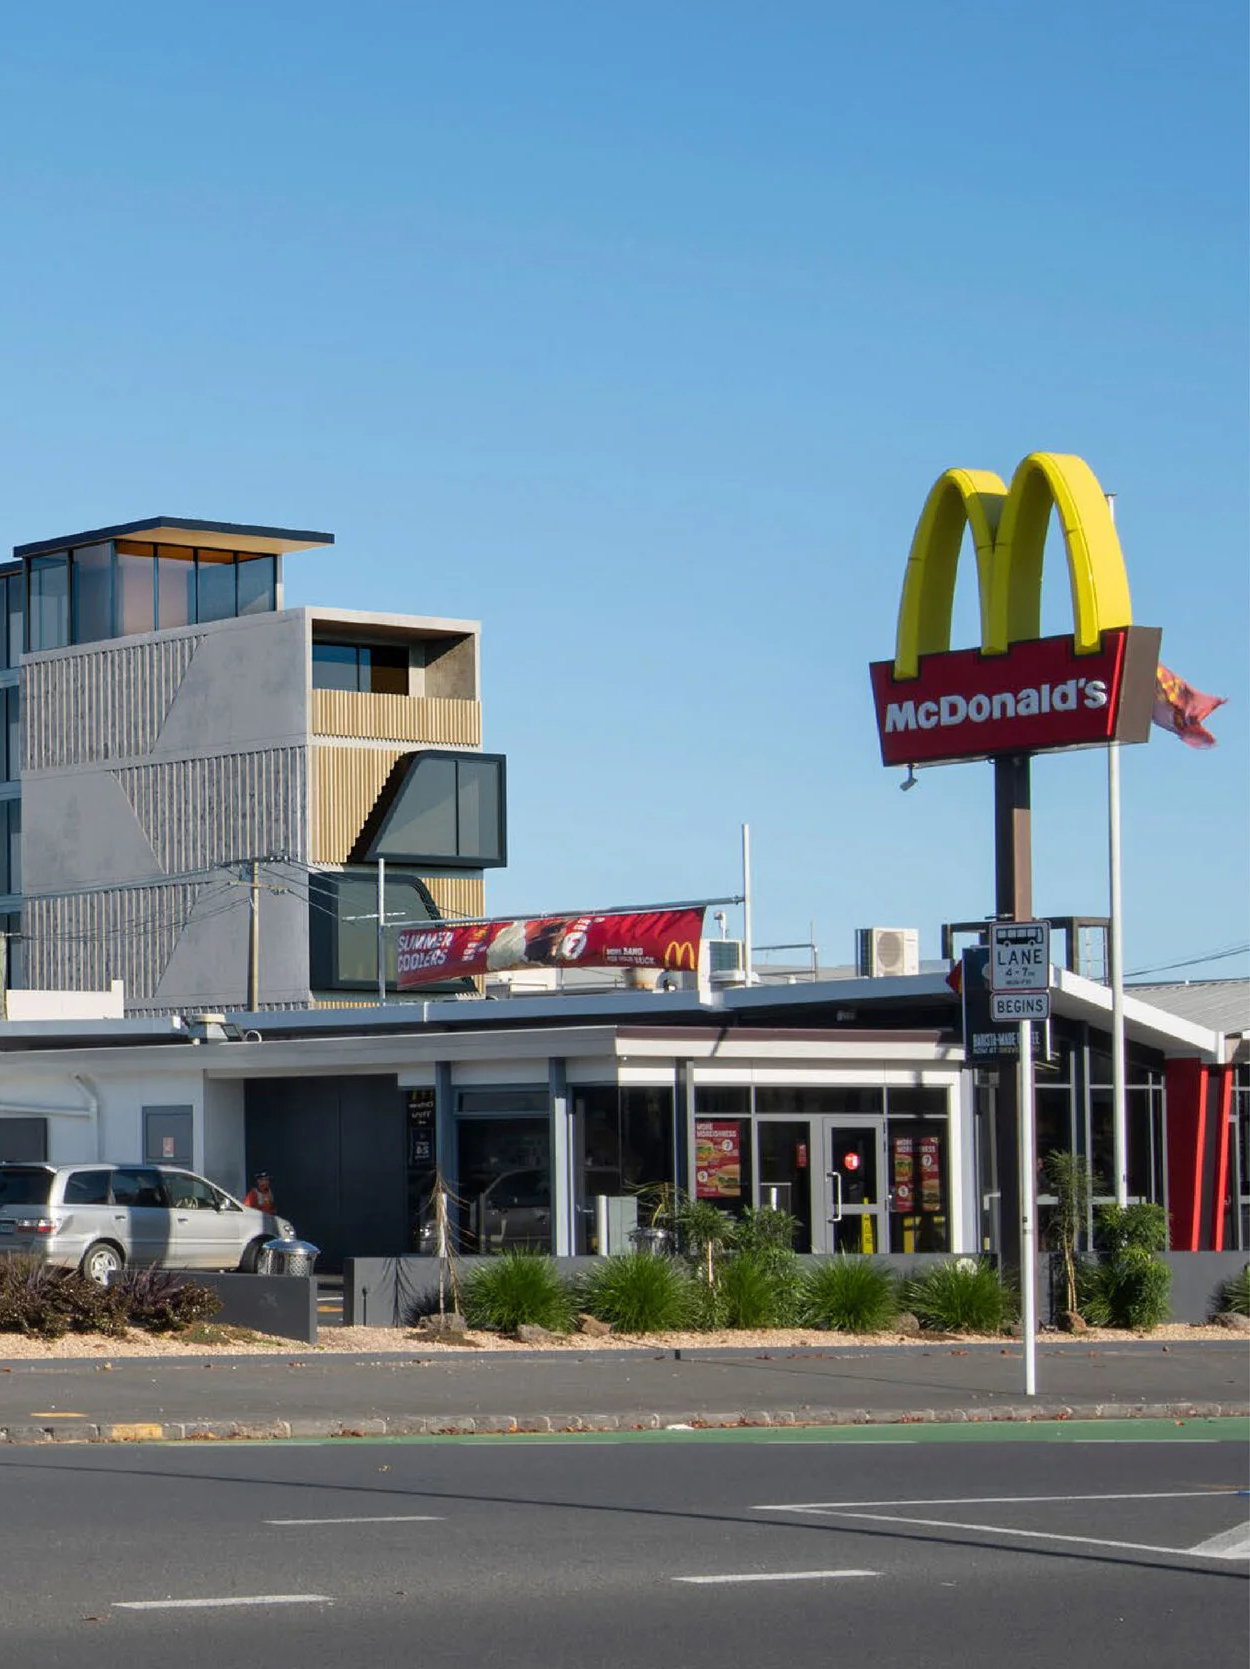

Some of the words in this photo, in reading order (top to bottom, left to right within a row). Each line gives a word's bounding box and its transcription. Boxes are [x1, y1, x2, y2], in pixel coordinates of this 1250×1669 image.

[885, 678, 1108, 733] McDonald's
[398, 931, 454, 952] SUMMER
[397, 949, 447, 973] COOLERS
[997, 948, 1043, 966] LANE
[997, 998, 1044, 1014] BEGINS
